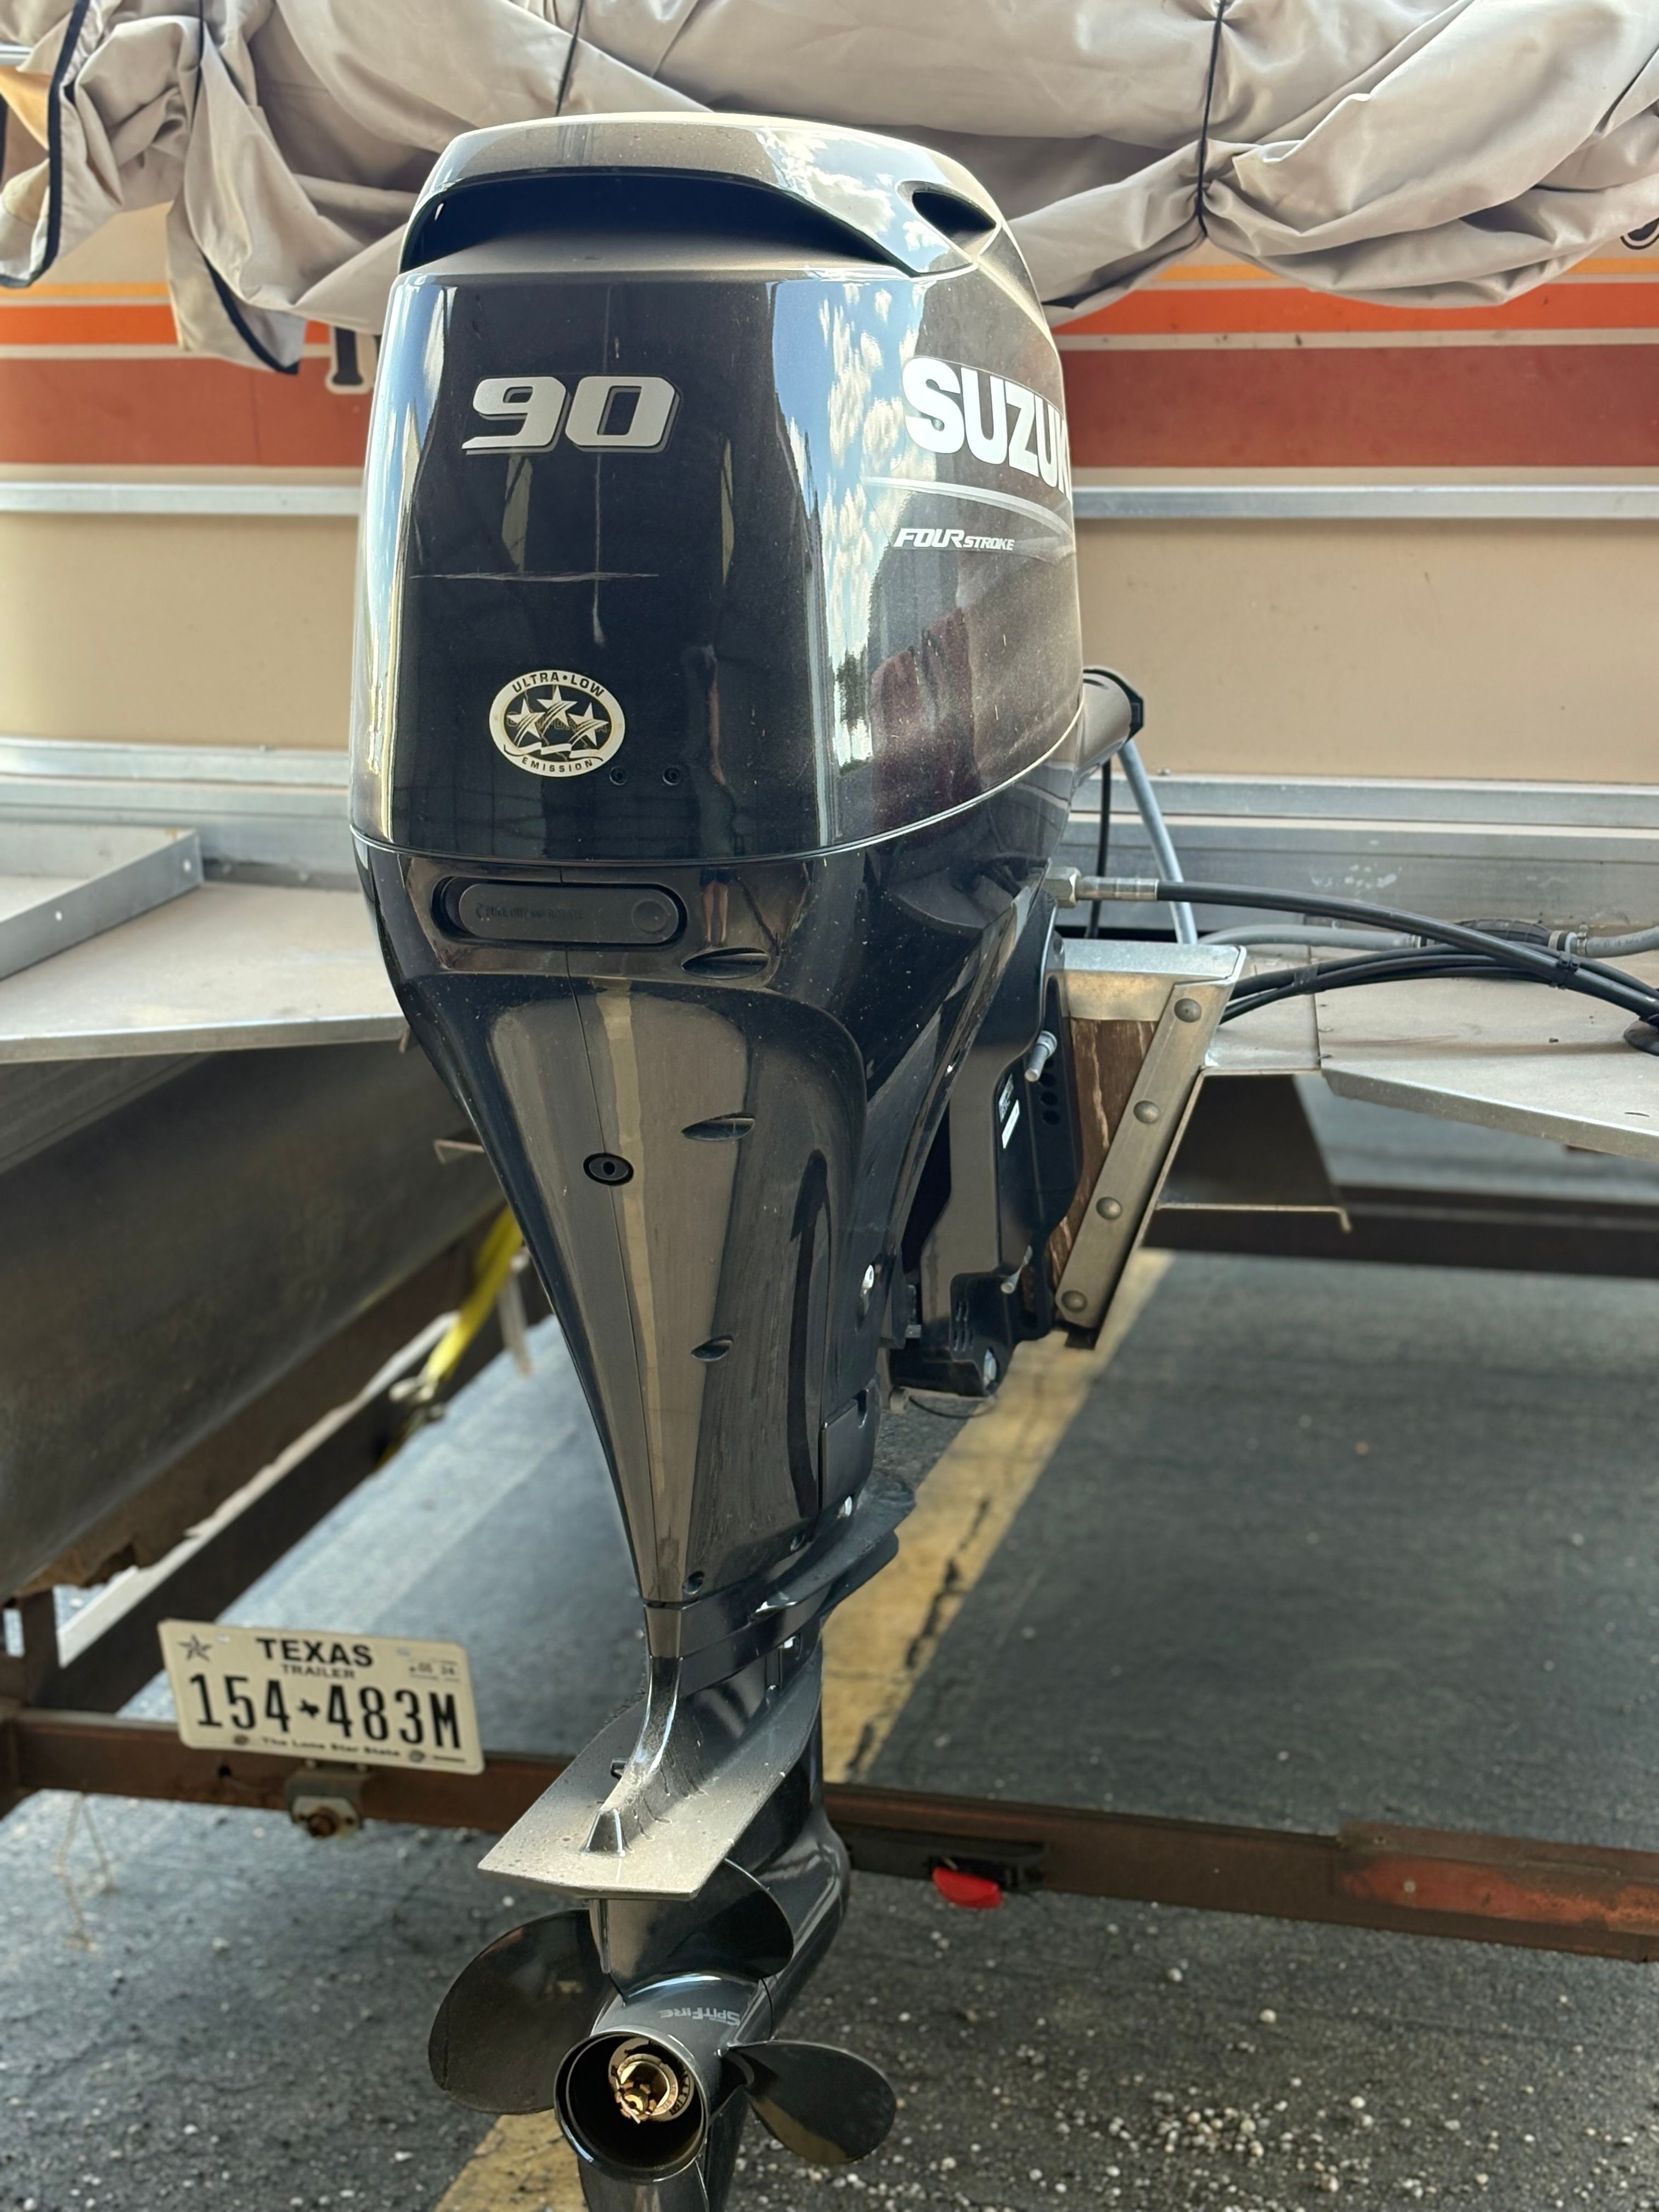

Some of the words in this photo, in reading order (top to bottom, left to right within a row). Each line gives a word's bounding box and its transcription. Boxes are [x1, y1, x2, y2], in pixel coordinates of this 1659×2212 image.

[462, 376, 679, 453] 90
[902, 358, 1072, 504] SUZUK
[893, 528, 964, 548] FOUR
[963, 535, 1015, 551] STROKE
[511, 672, 560, 693] ULTRA
[571, 675, 605, 698] LOW
[522, 757, 594, 773] EMISSION
[256, 1637, 374, 1668] TEXAS
[282, 1663, 356, 1679] TRAILER
[189, 1673, 291, 1733] 154
[327, 1684, 461, 1750] 483M
